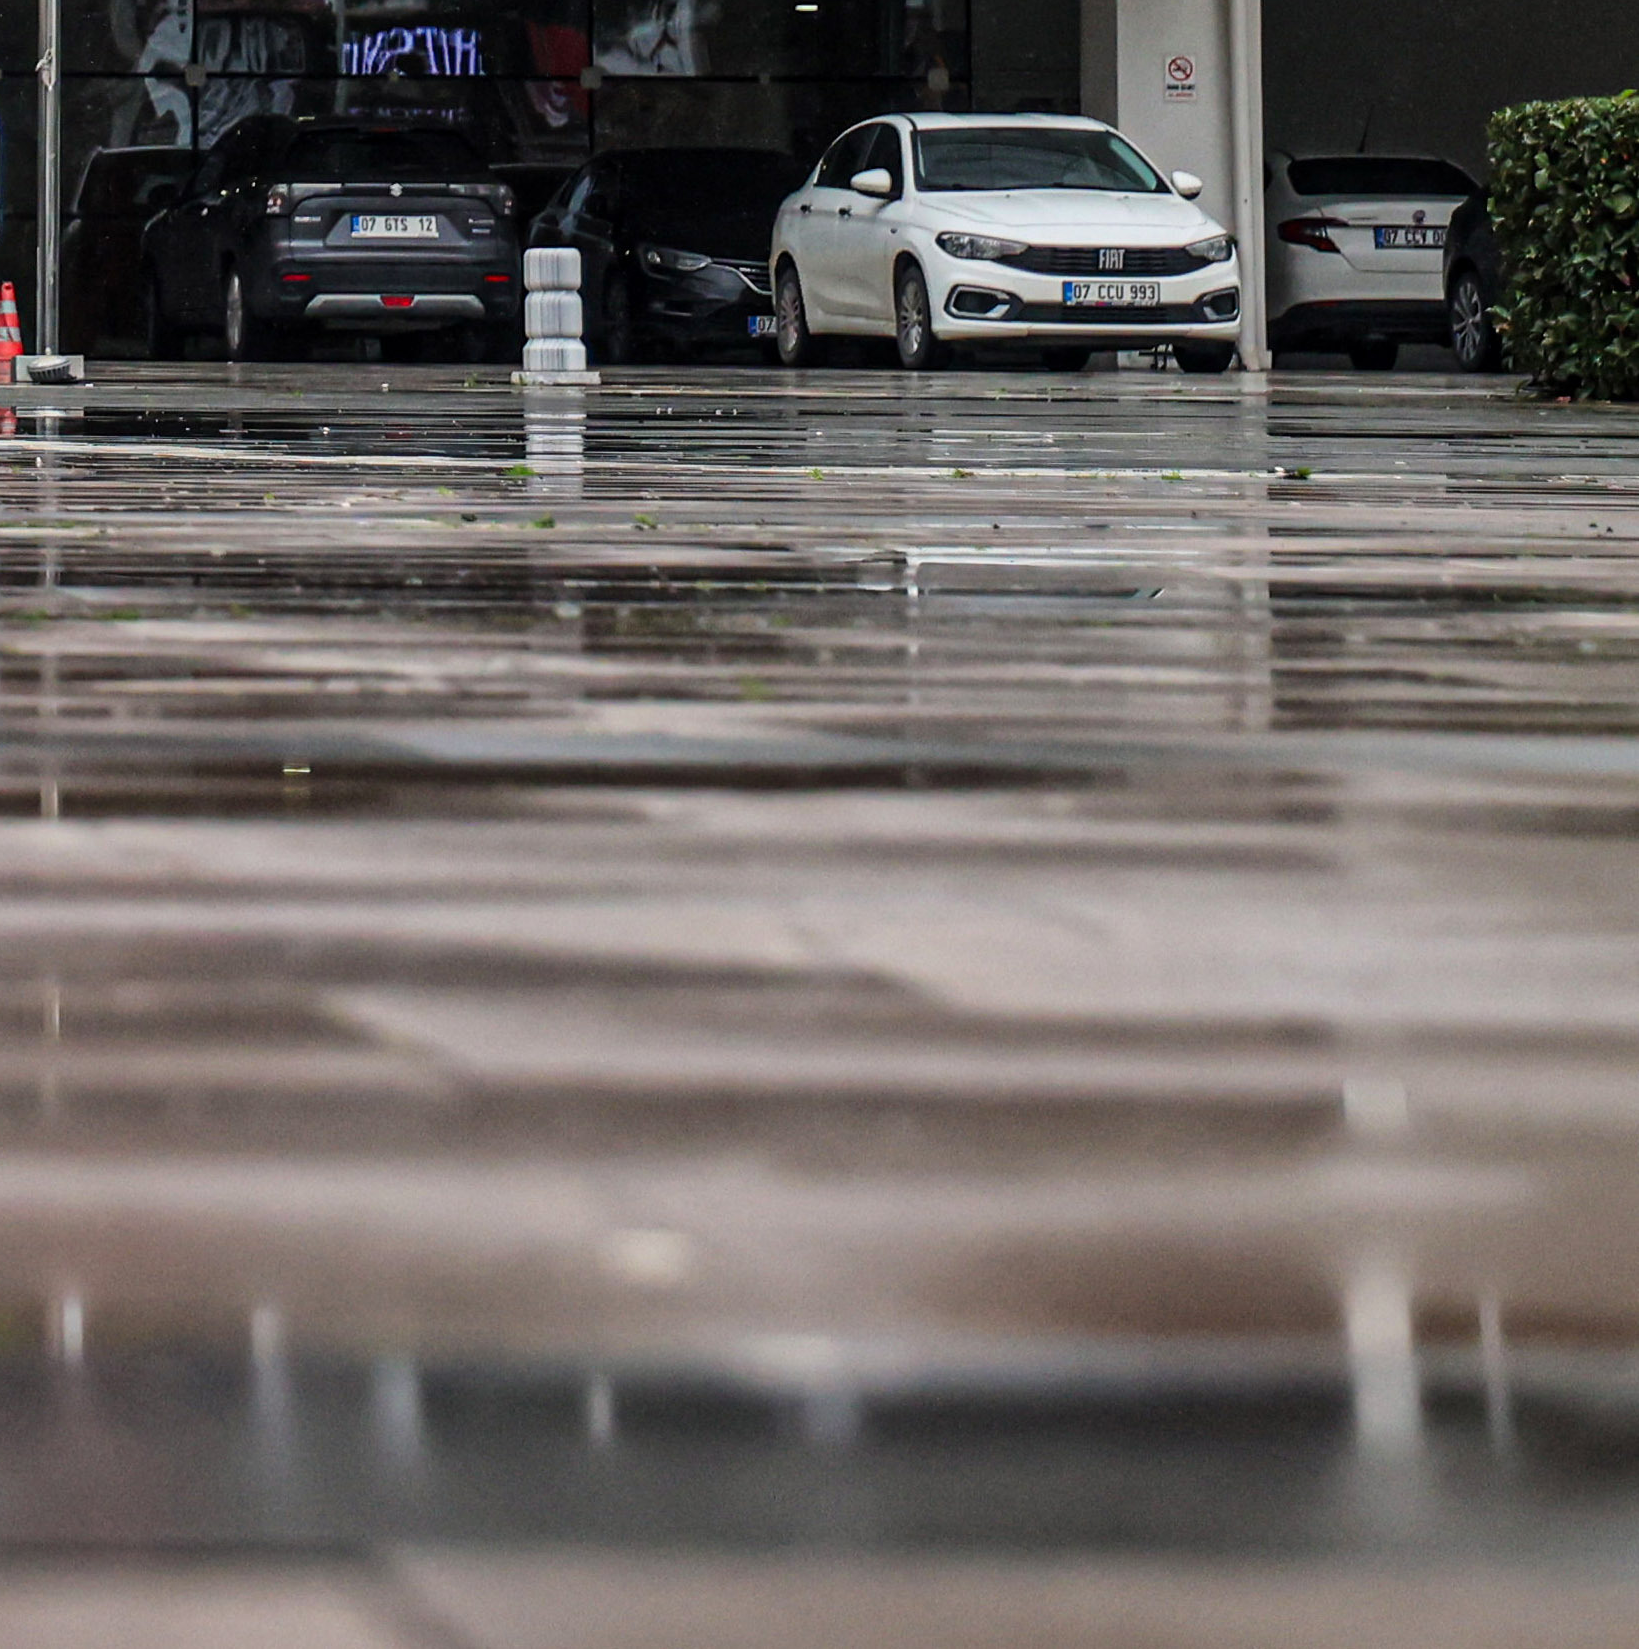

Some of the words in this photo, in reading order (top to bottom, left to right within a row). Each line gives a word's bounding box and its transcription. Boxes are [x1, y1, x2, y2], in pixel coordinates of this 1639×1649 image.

[361, 218, 376, 231] 07
[384, 218, 408, 231] GTS
[420, 218, 433, 231] 12
[1099, 249, 1125, 269] FIAT
[1073, 284, 1091, 299] 07
[1098, 284, 1124, 299] CCU
[1130, 285, 1155, 299] 993
[758, 317, 773, 331] 07
